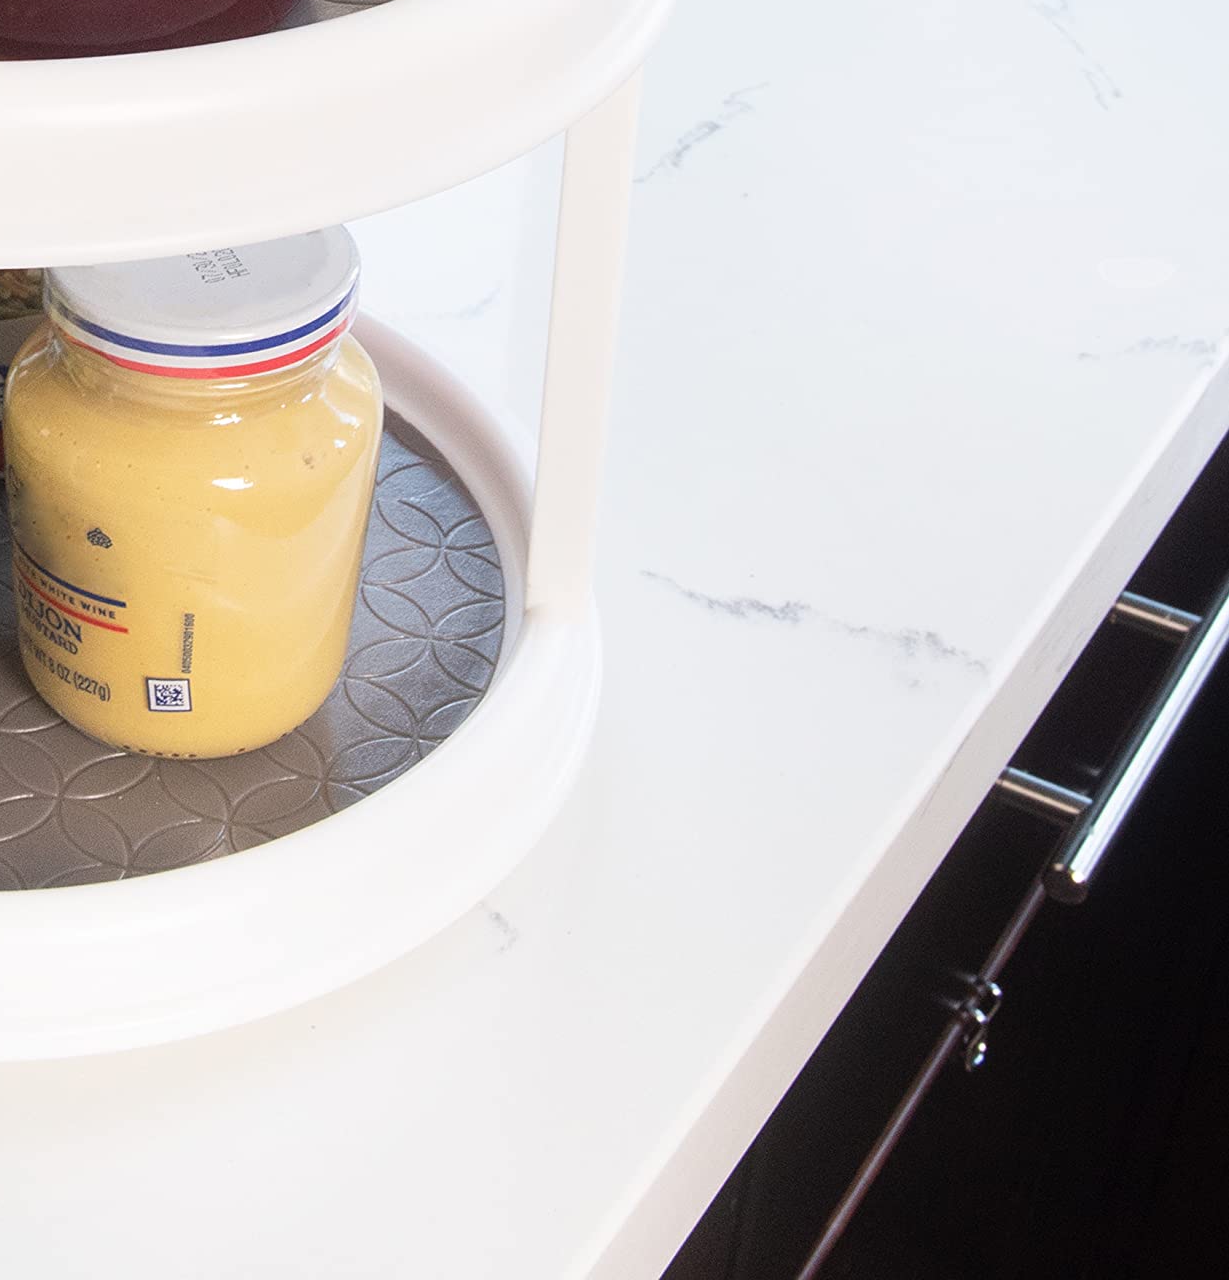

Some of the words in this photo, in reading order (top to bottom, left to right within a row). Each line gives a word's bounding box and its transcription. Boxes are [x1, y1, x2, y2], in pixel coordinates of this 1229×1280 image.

[40, 579, 75, 606] WHITE
[80, 600, 116, 620] WINE
[56, 662, 72, 685] OZ
[72, 669, 112, 703] (227g)
